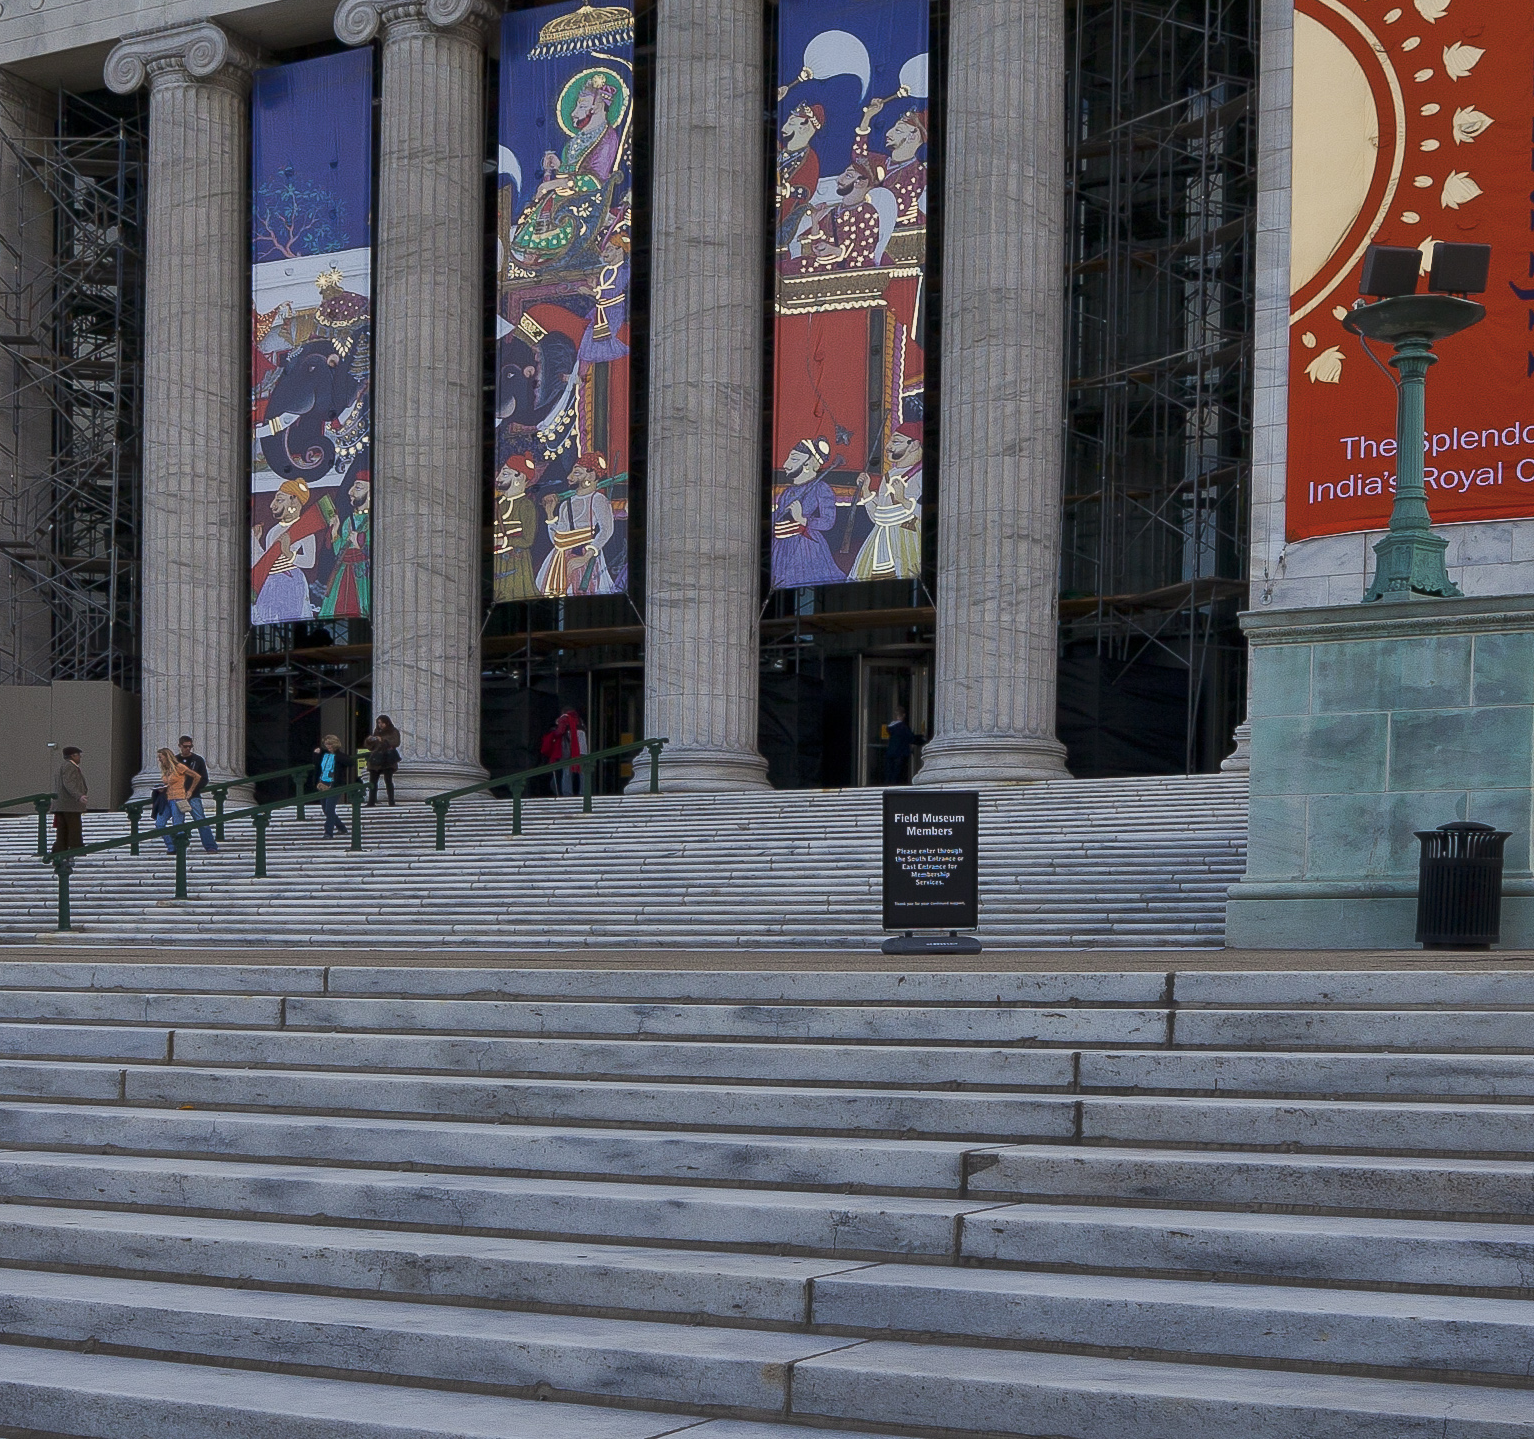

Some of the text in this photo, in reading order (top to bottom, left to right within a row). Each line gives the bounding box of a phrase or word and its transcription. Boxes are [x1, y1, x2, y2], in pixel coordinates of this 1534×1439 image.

[1339, 435, 1397, 460] The
[894, 813, 965, 823] Field Museum
[906, 826, 953, 836] Members
